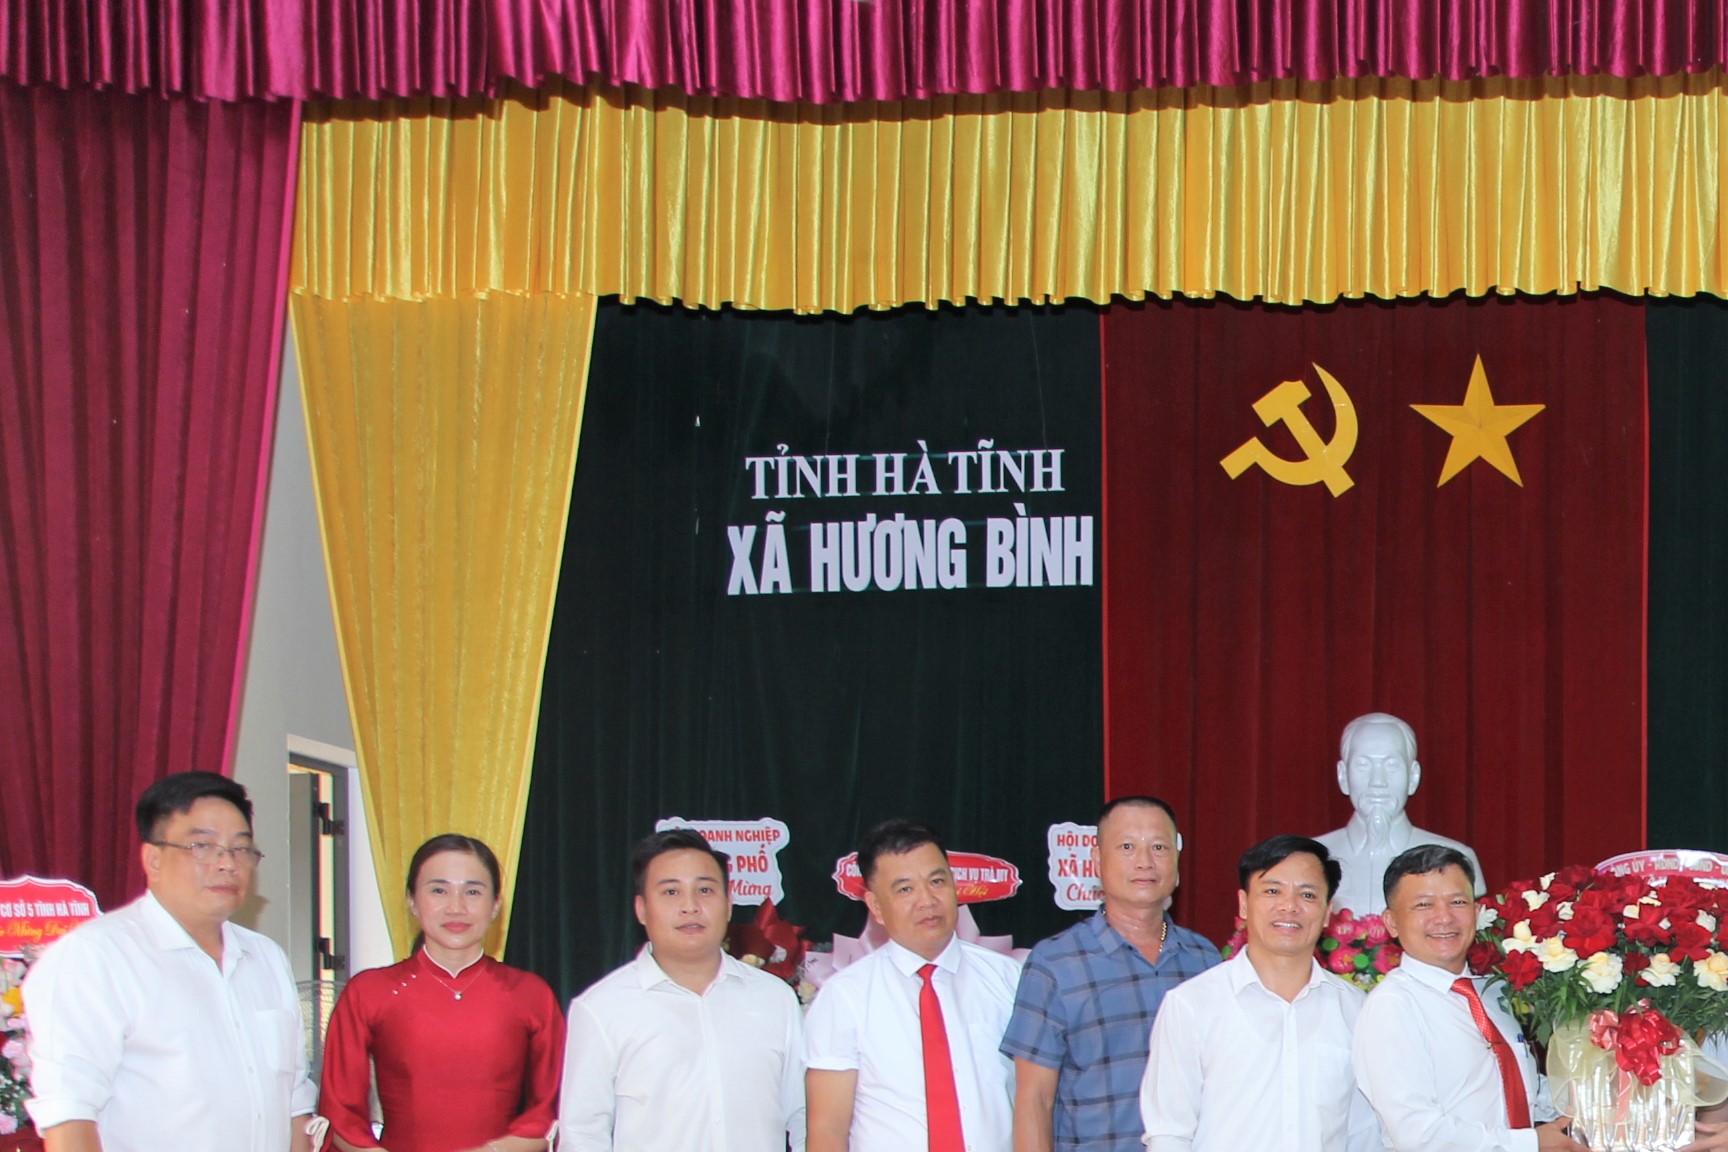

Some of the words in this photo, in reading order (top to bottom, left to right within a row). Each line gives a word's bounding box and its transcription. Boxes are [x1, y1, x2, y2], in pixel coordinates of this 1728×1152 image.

[745, 444, 860, 499] TỈNH
[872, 440, 941, 496] HÀ
[948, 438, 1065, 494] TĨNH
[727, 511, 793, 595] XÃ
[810, 513, 967, 592] HƯƠNG
[986, 502, 1093, 588] BÌNH
[735, 826, 780, 845] NGHIỆP
[1057, 831, 1079, 851] HỘI
[736, 843, 768, 873] PHỐ
[1058, 854, 1078, 877] XÃ
